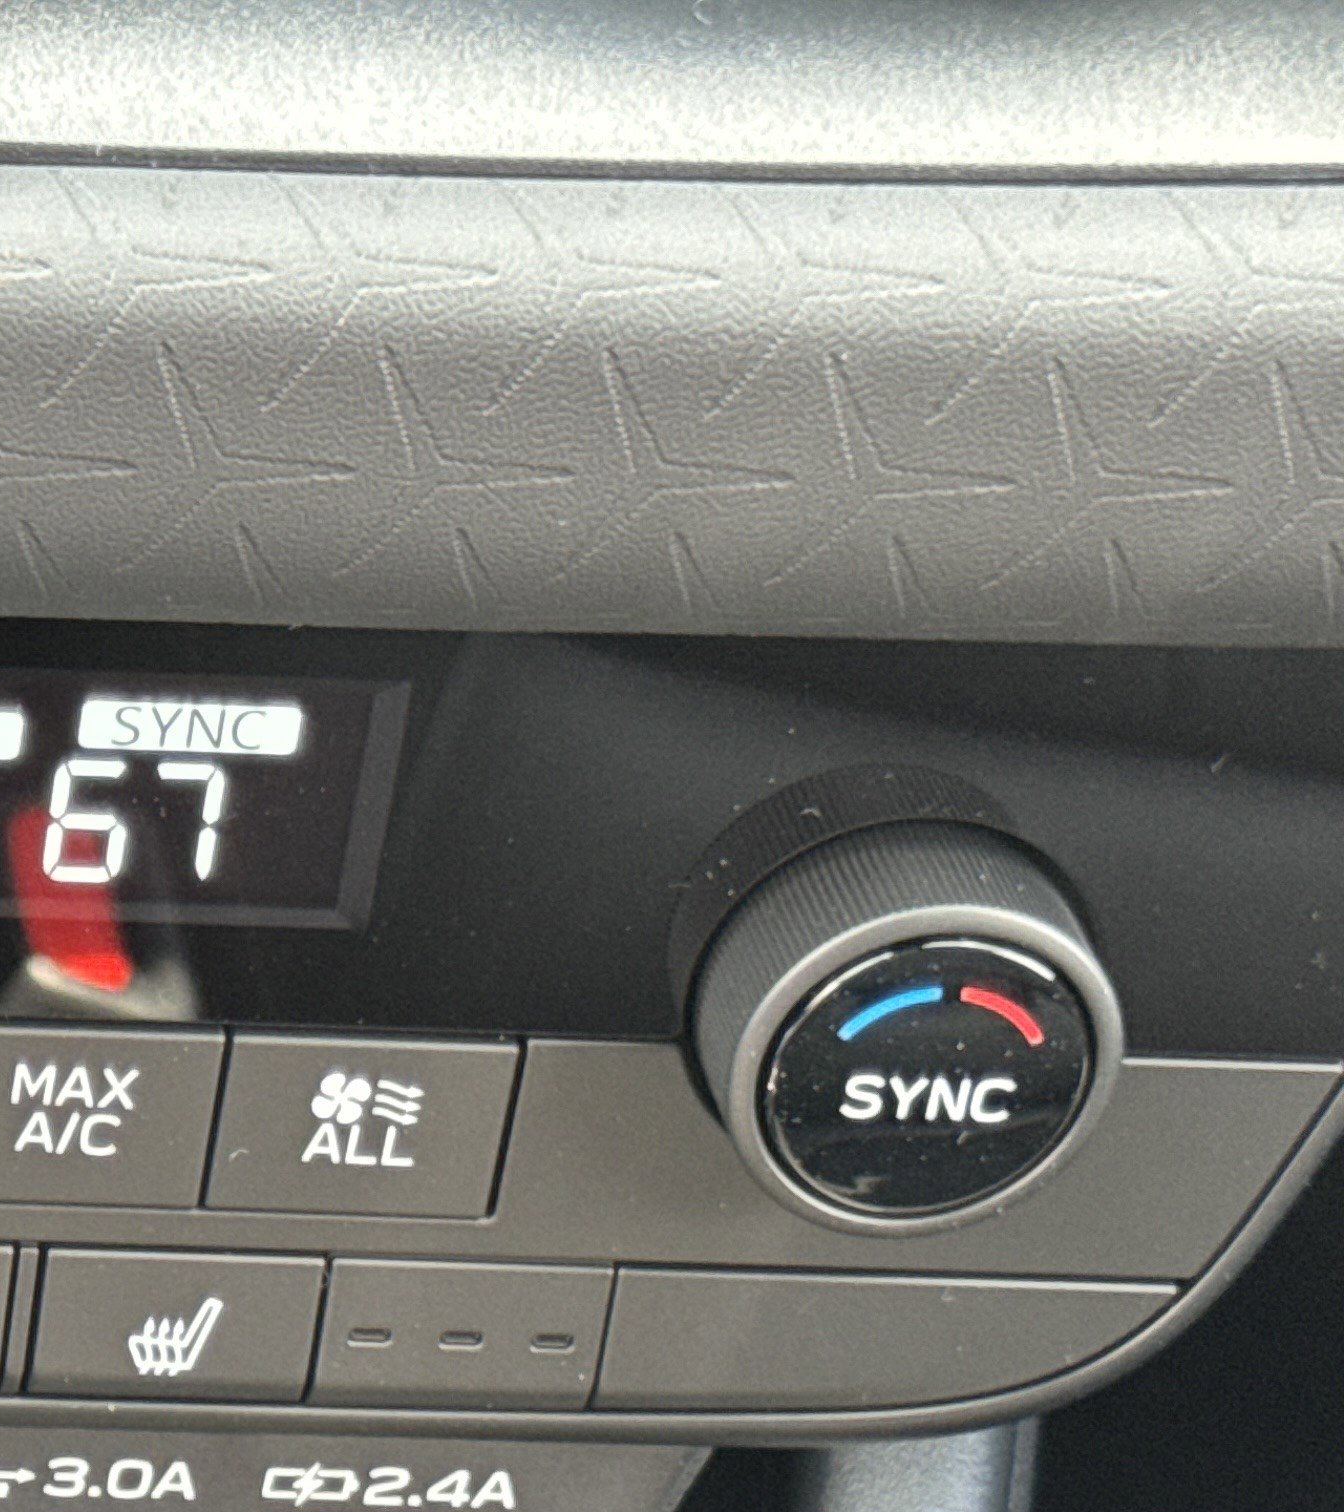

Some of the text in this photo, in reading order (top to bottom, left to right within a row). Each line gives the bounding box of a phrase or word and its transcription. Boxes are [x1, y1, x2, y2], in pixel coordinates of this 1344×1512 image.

[111, 705, 267, 751] SYNC
[43, 759, 226, 883] 67
[10, 1063, 141, 1111] MAX
[838, 1073, 1018, 1124] SYNC
[14, 1112, 122, 1157] A/C
[301, 1124, 415, 1168] ALL
[42, 1456, 197, 1501] 3.0A
[362, 1465, 517, 1510] 2.4A
